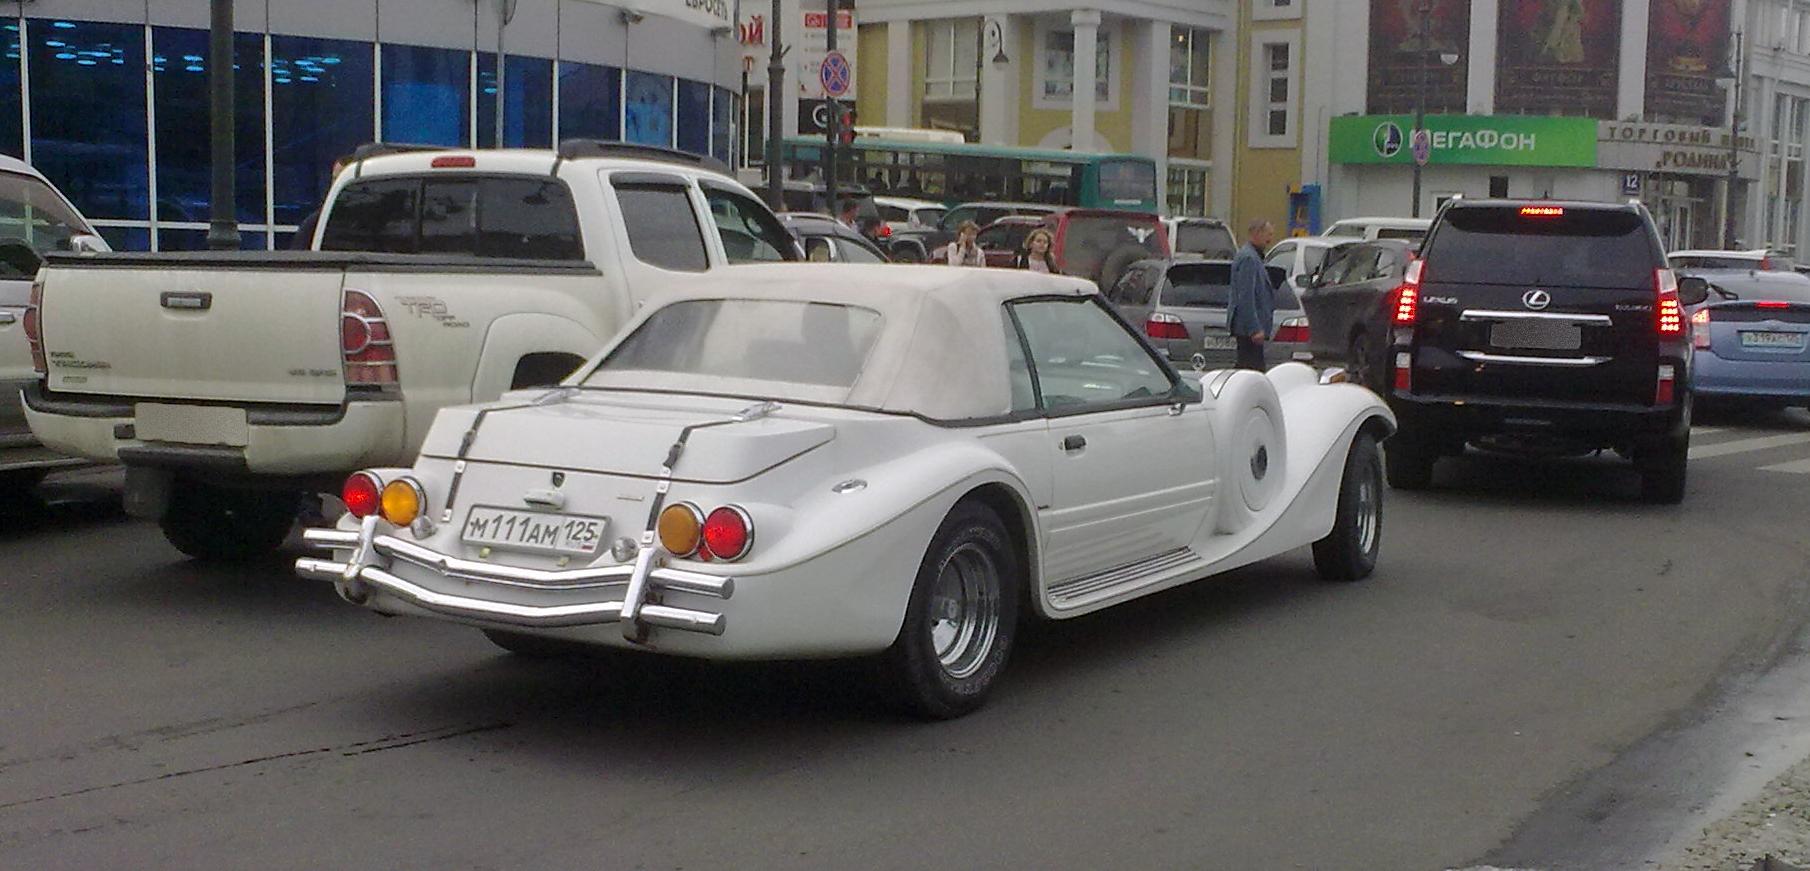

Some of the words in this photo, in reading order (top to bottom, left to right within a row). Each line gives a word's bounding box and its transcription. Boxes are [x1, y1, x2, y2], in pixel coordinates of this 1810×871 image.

[1626, 174, 1638, 188] 12
[470, 514, 559, 545] М111АМ
[565, 519, 598, 542] 125
